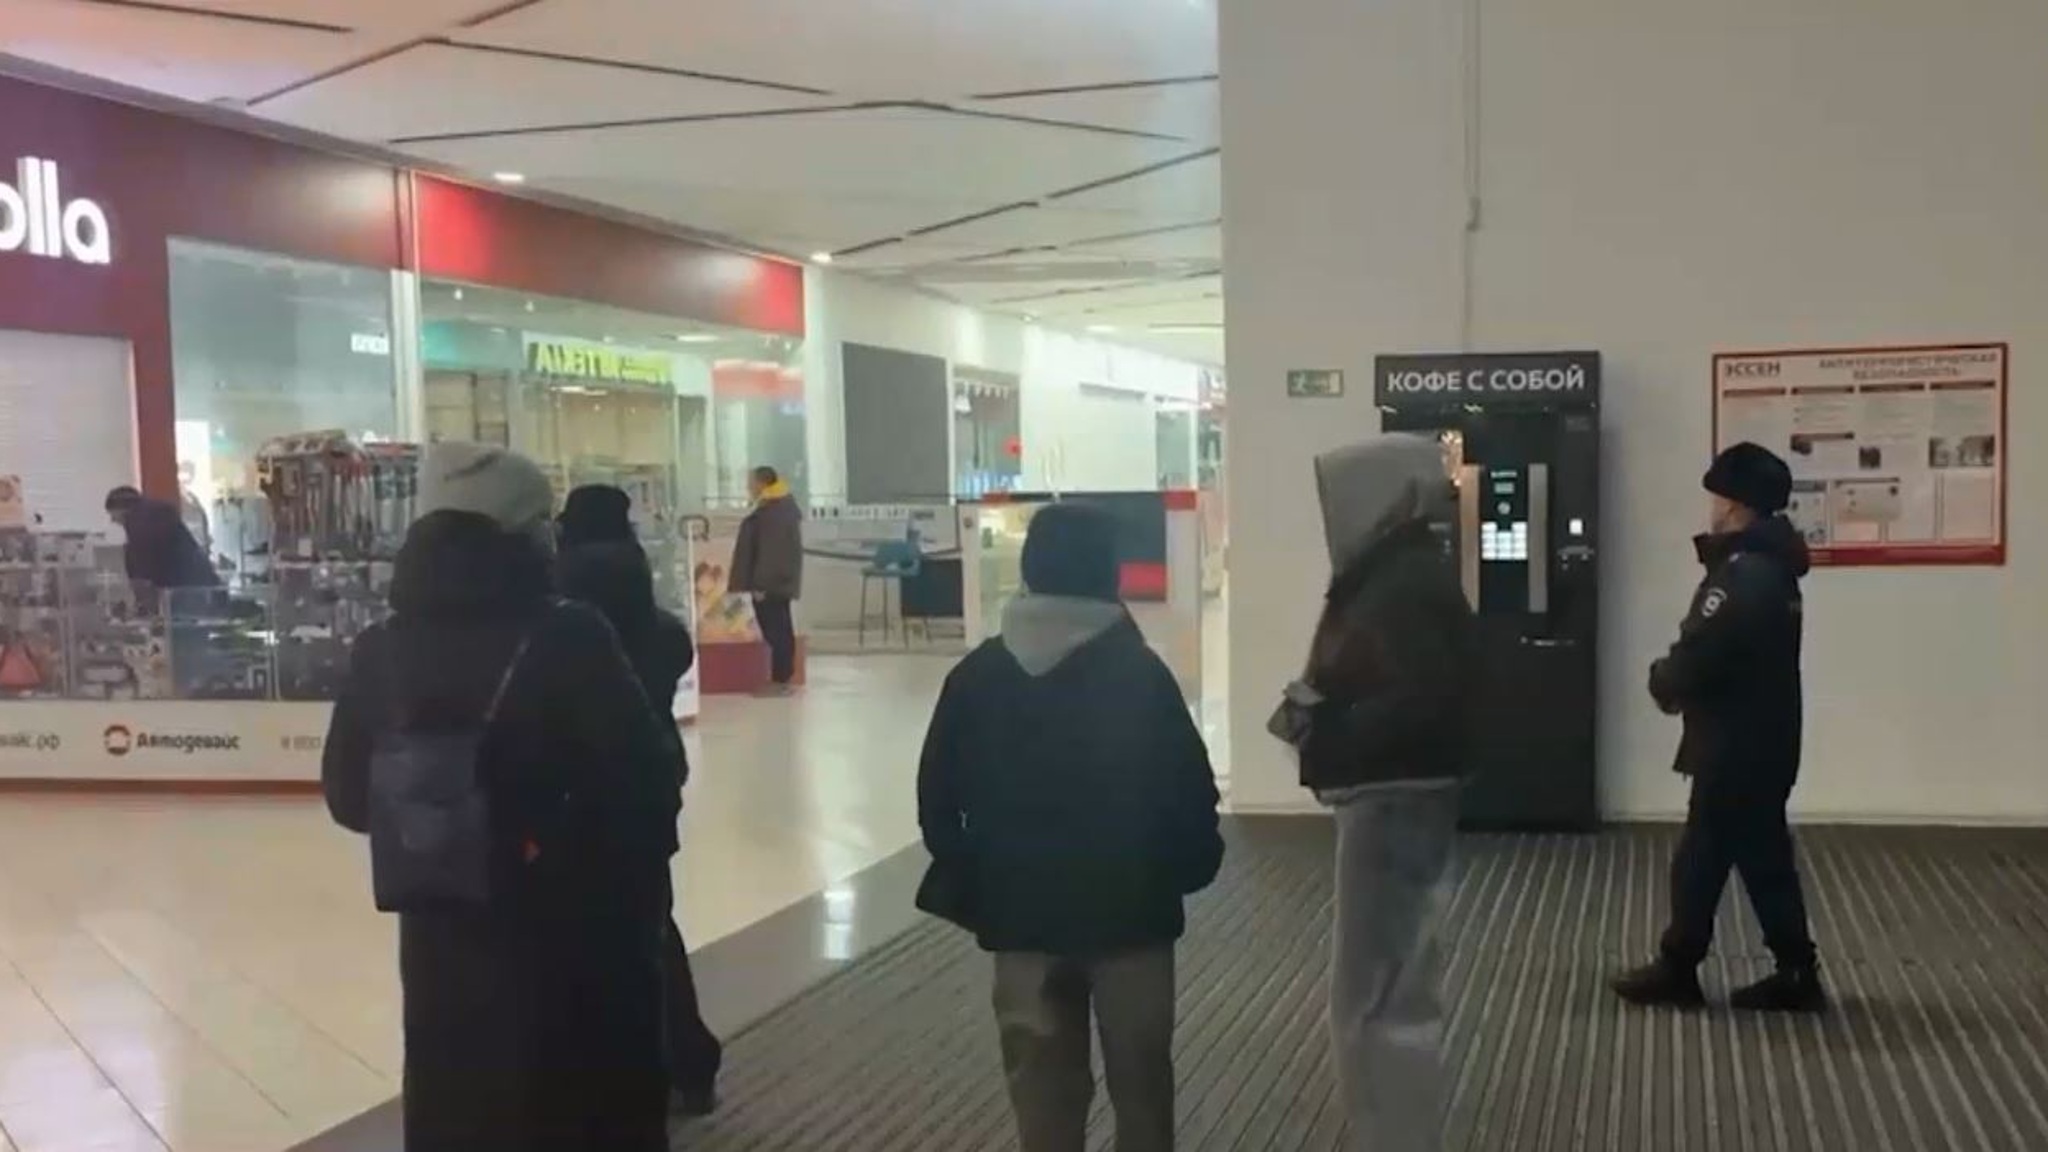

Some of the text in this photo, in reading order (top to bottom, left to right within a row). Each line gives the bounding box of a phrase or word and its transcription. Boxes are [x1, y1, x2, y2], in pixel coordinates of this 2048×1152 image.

[1387, 364, 1585, 392] КОФЕ С СОБОЙ
[1724, 361, 1781, 378] ЭССЕН
